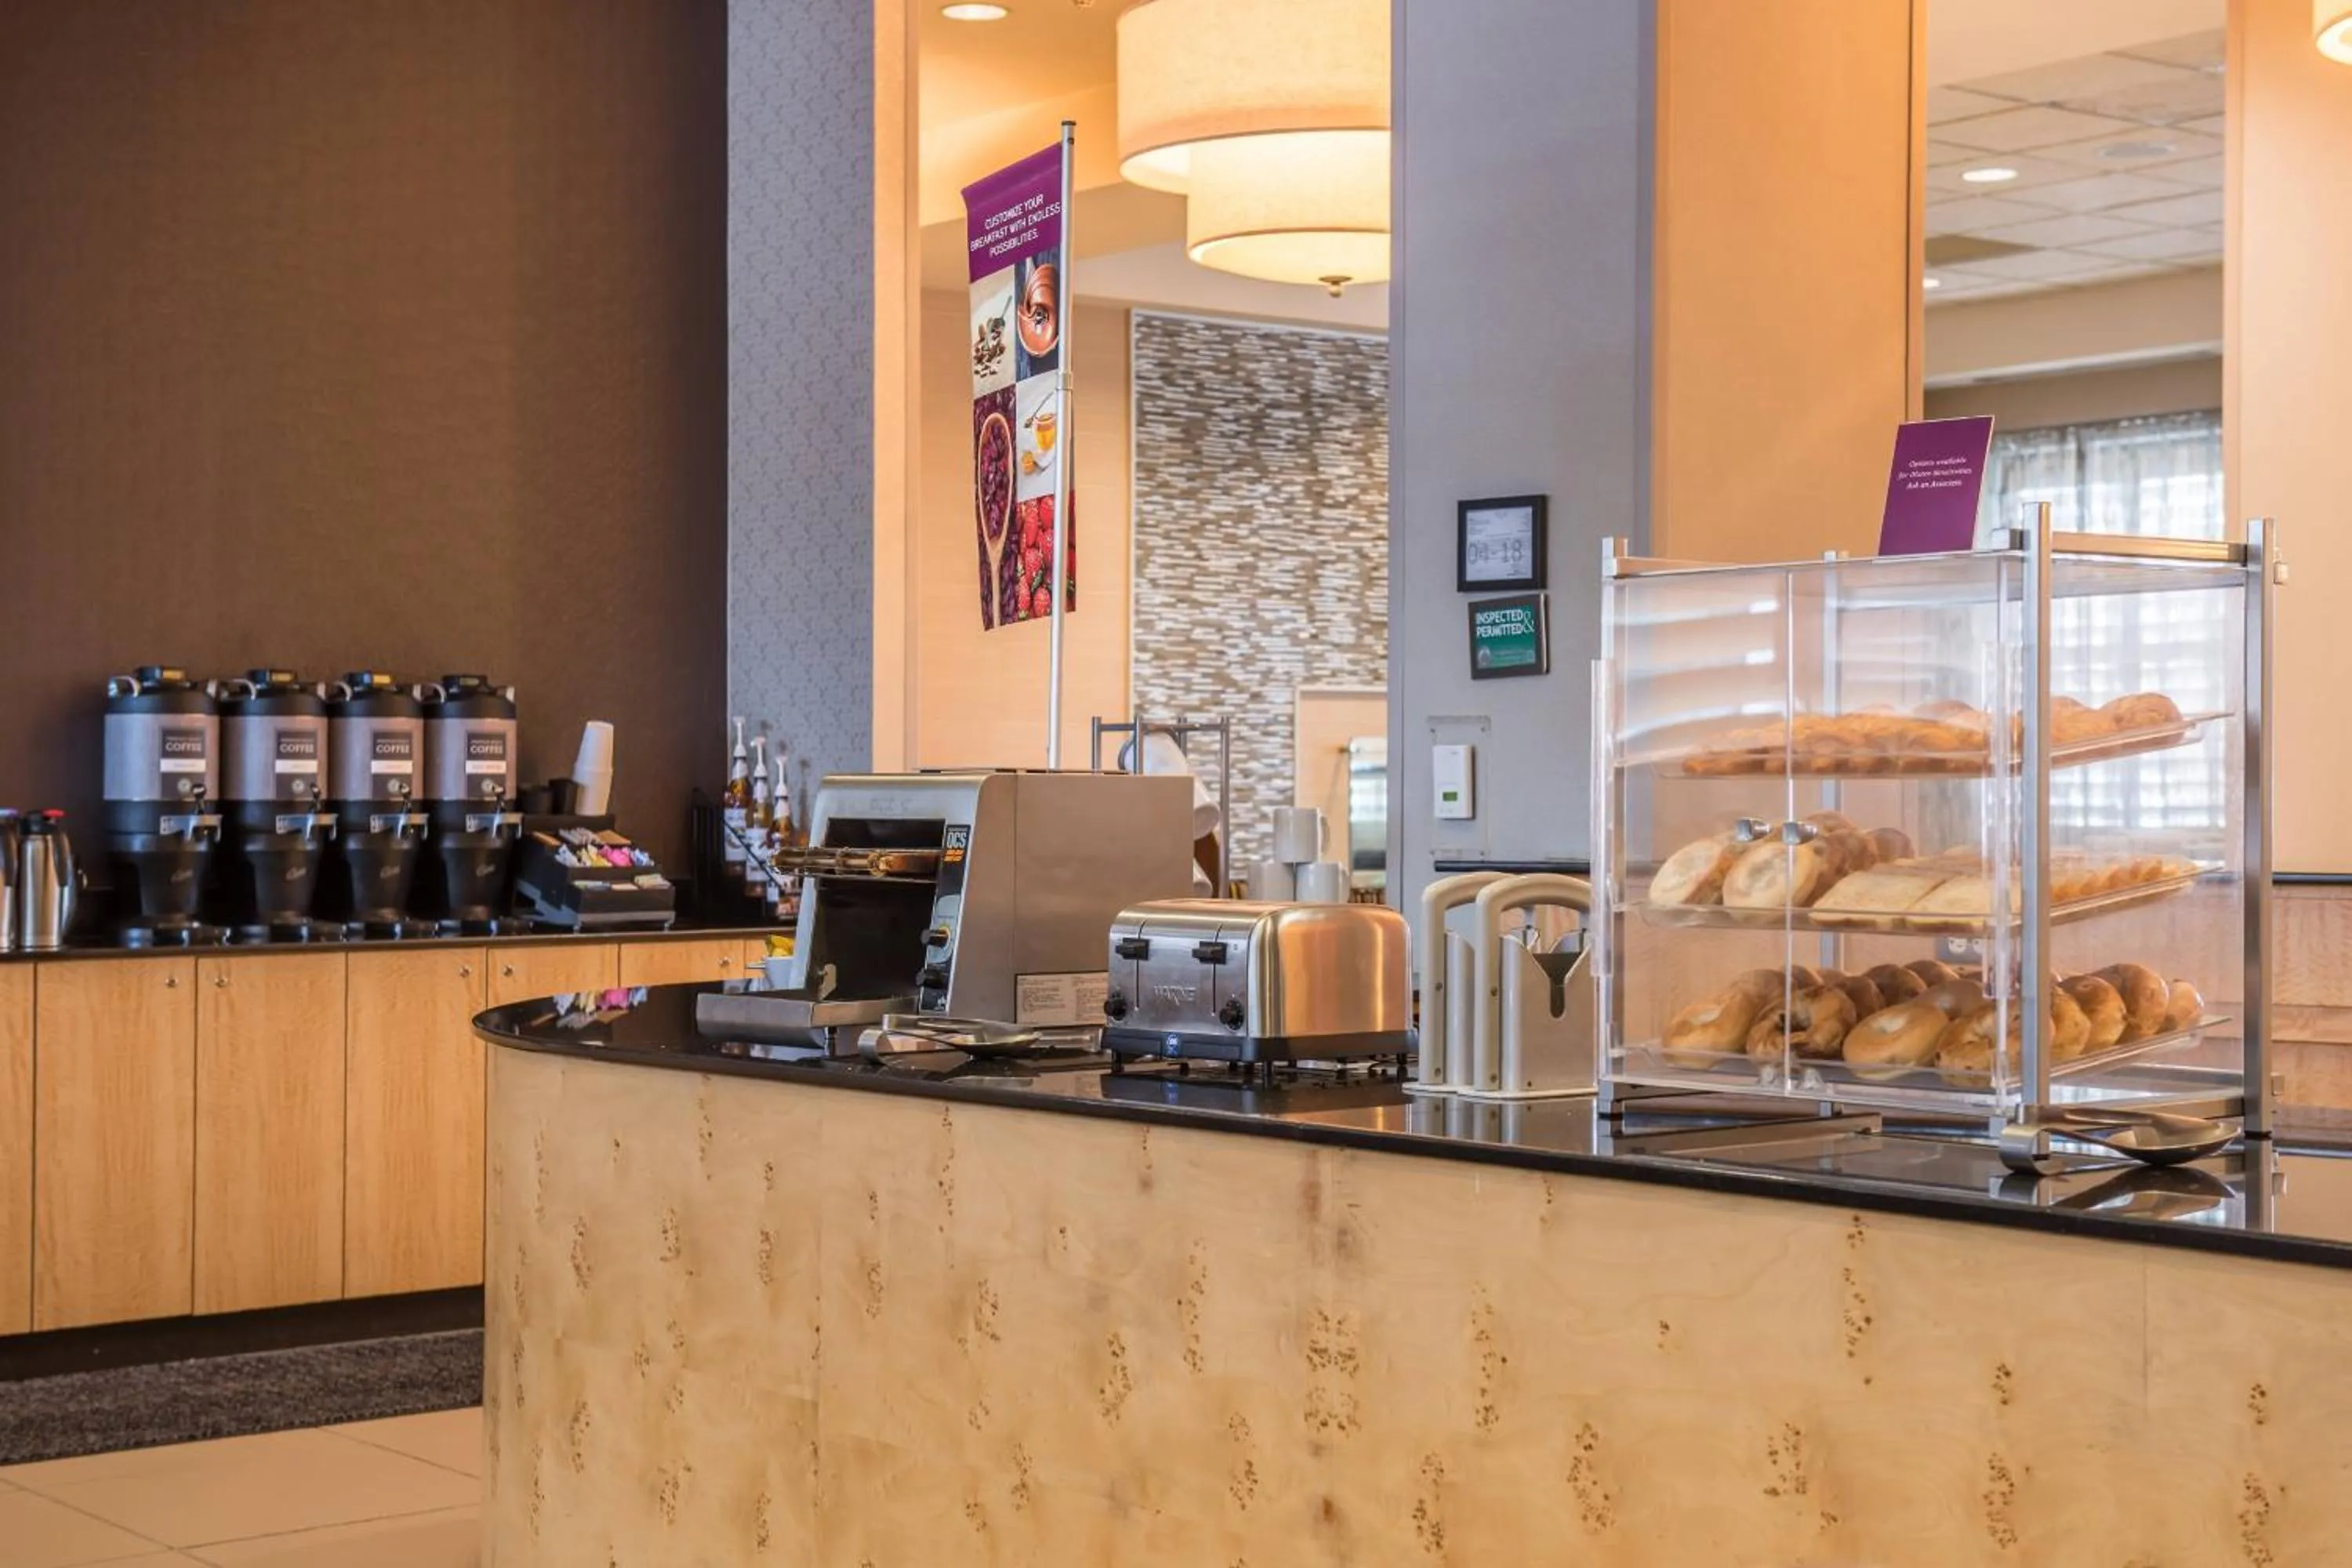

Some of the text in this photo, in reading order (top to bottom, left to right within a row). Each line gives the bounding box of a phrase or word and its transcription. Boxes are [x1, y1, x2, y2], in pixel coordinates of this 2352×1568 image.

[985, 194, 1044, 230] CUSTOMIZE YOUR
[971, 202, 1061, 252] BREAKFAST WITH ENDLESS
[1476, 609, 1523, 625] INSPECTED
[1476, 623, 1523, 638] PERMITTED
[376, 744, 410, 754] COFFEE
